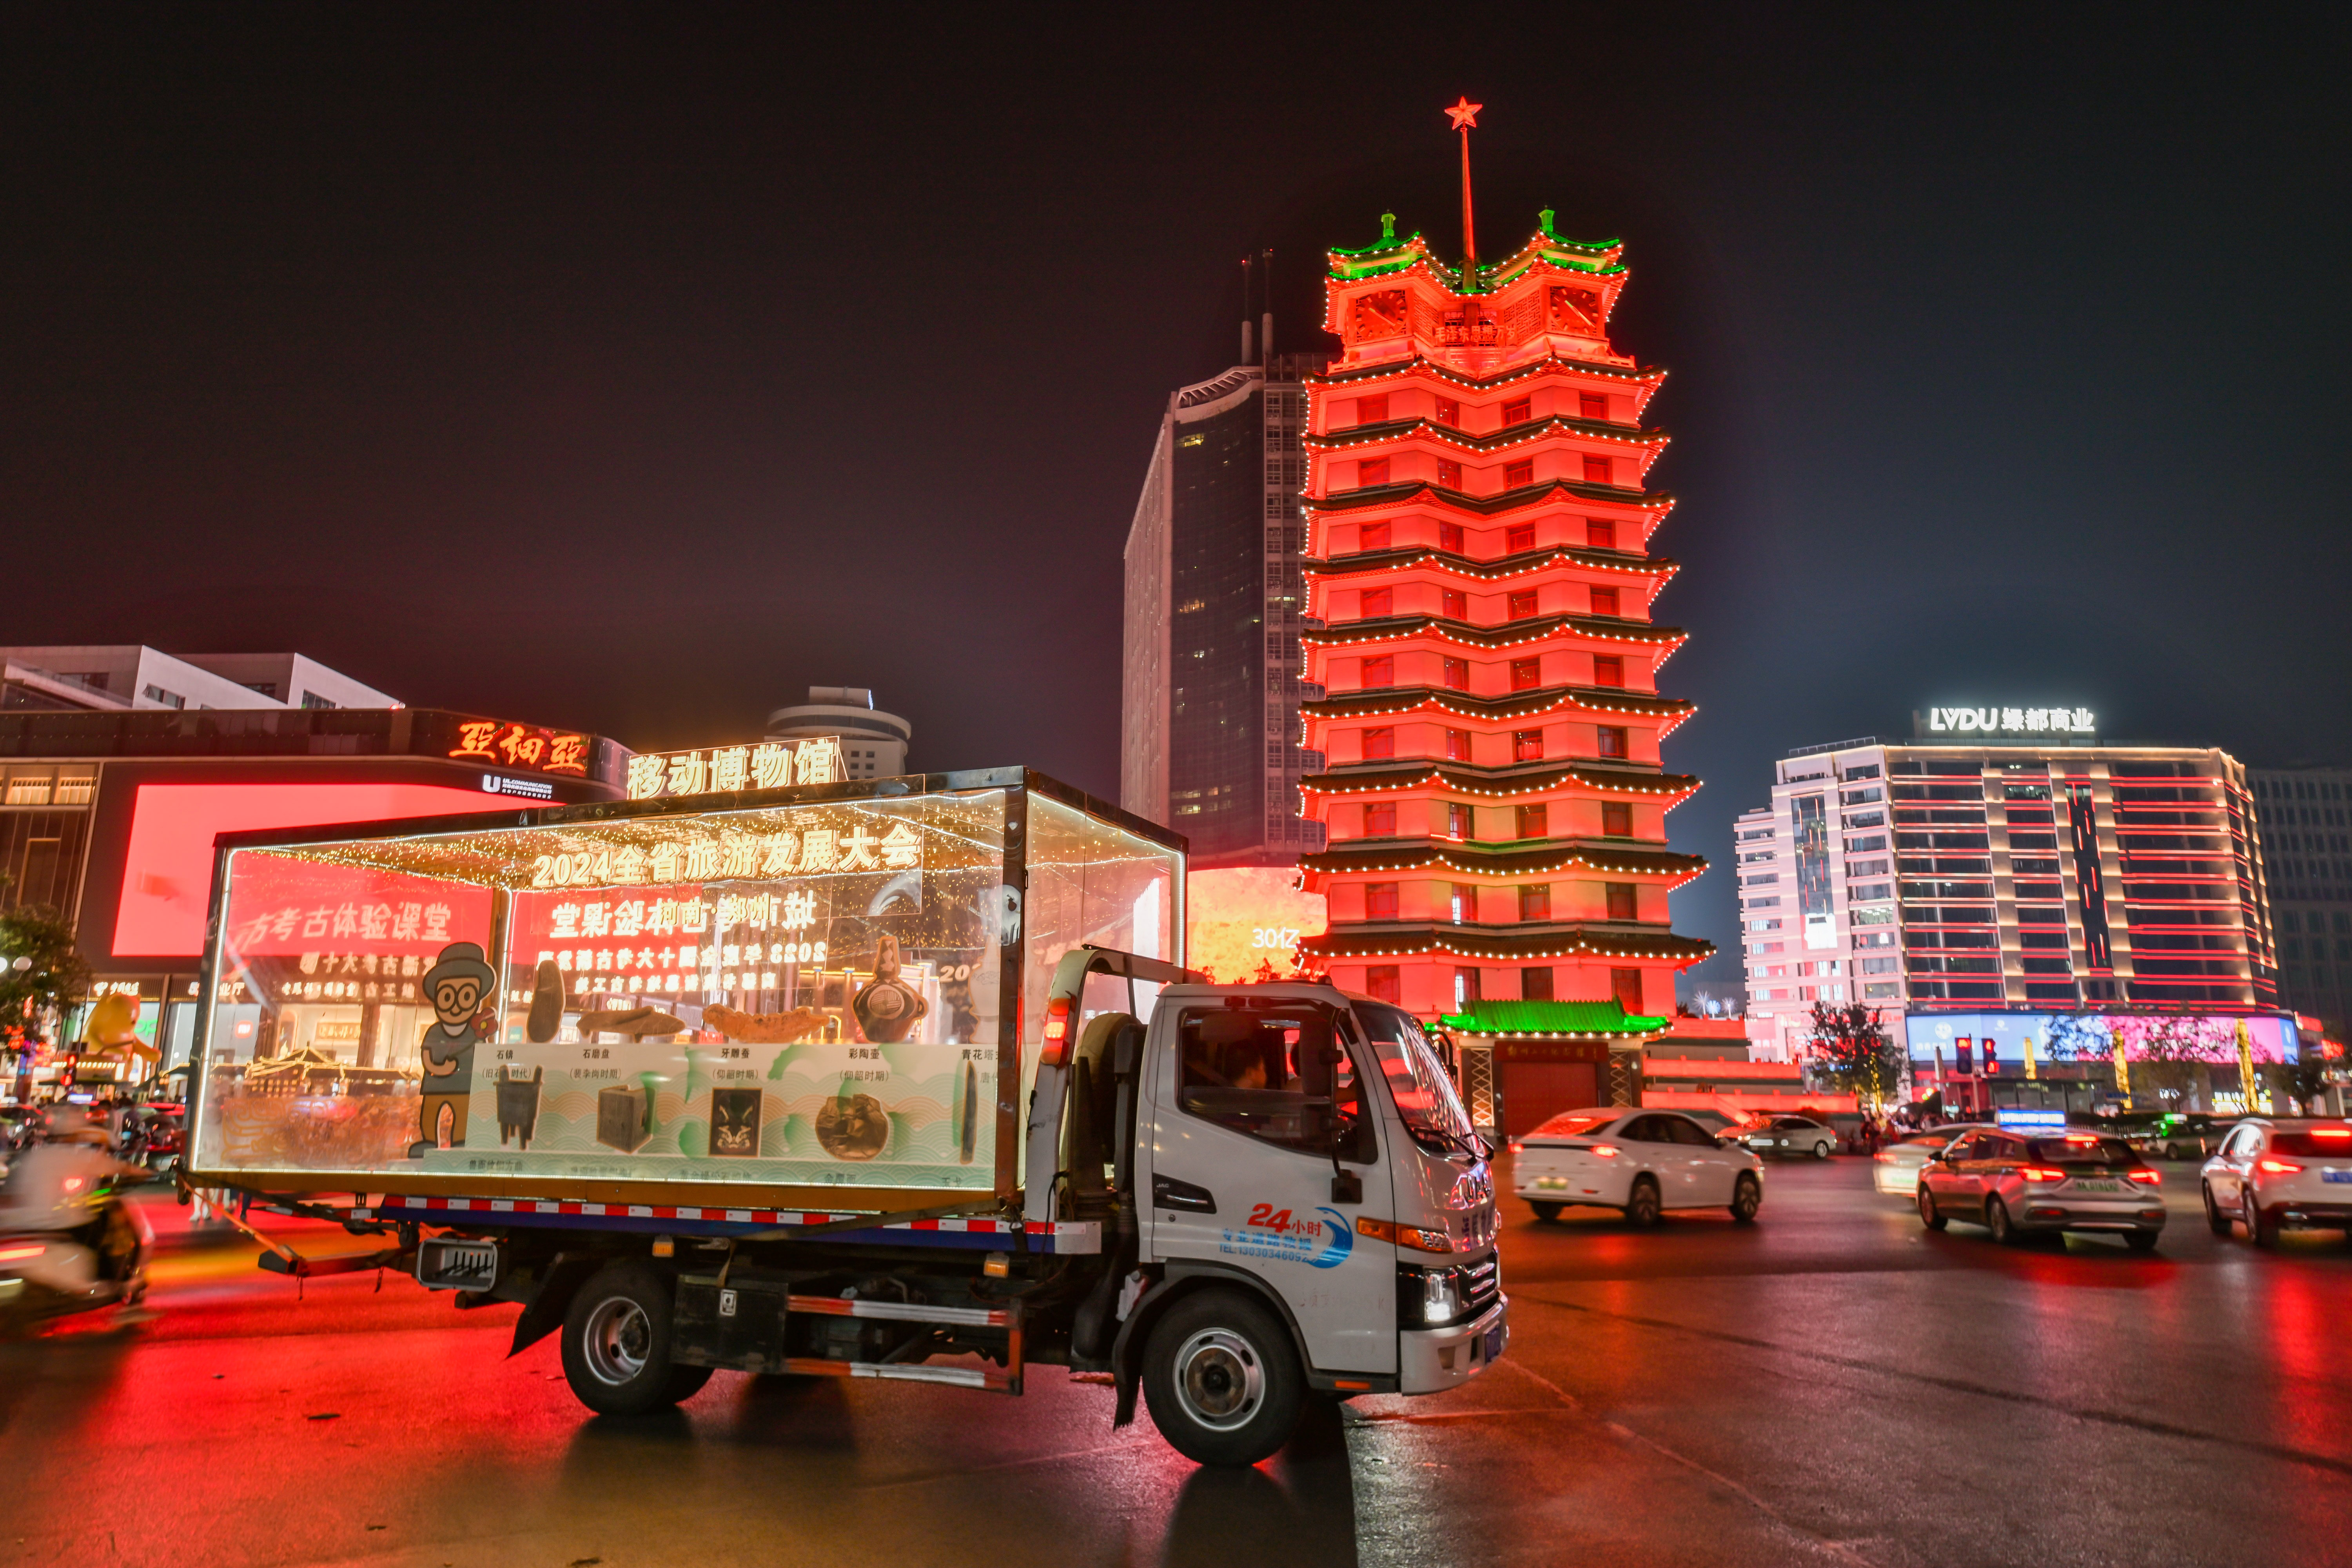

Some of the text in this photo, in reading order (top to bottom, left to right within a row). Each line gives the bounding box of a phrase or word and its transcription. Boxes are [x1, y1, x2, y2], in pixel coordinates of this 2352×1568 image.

[1435, 324, 1516, 343] 毛泽东思想万岁
[1930, 707, 2095, 732] LVDU 绿都商业
[628, 739, 837, 800] 移动博物馆
[532, 824, 922, 888] 2024全省旅游发展大会
[583, 1049, 610, 1059] 石磨盘
[721, 1048, 750, 1058] 牙雕蚕
[848, 1048, 880, 1059] 彩陶壶
[962, 1049, 998, 1060] 青花塔
[483, 1069, 531, 1079] （旧石时代）
[1222, 1229, 1312, 1251] 专业道路救援
